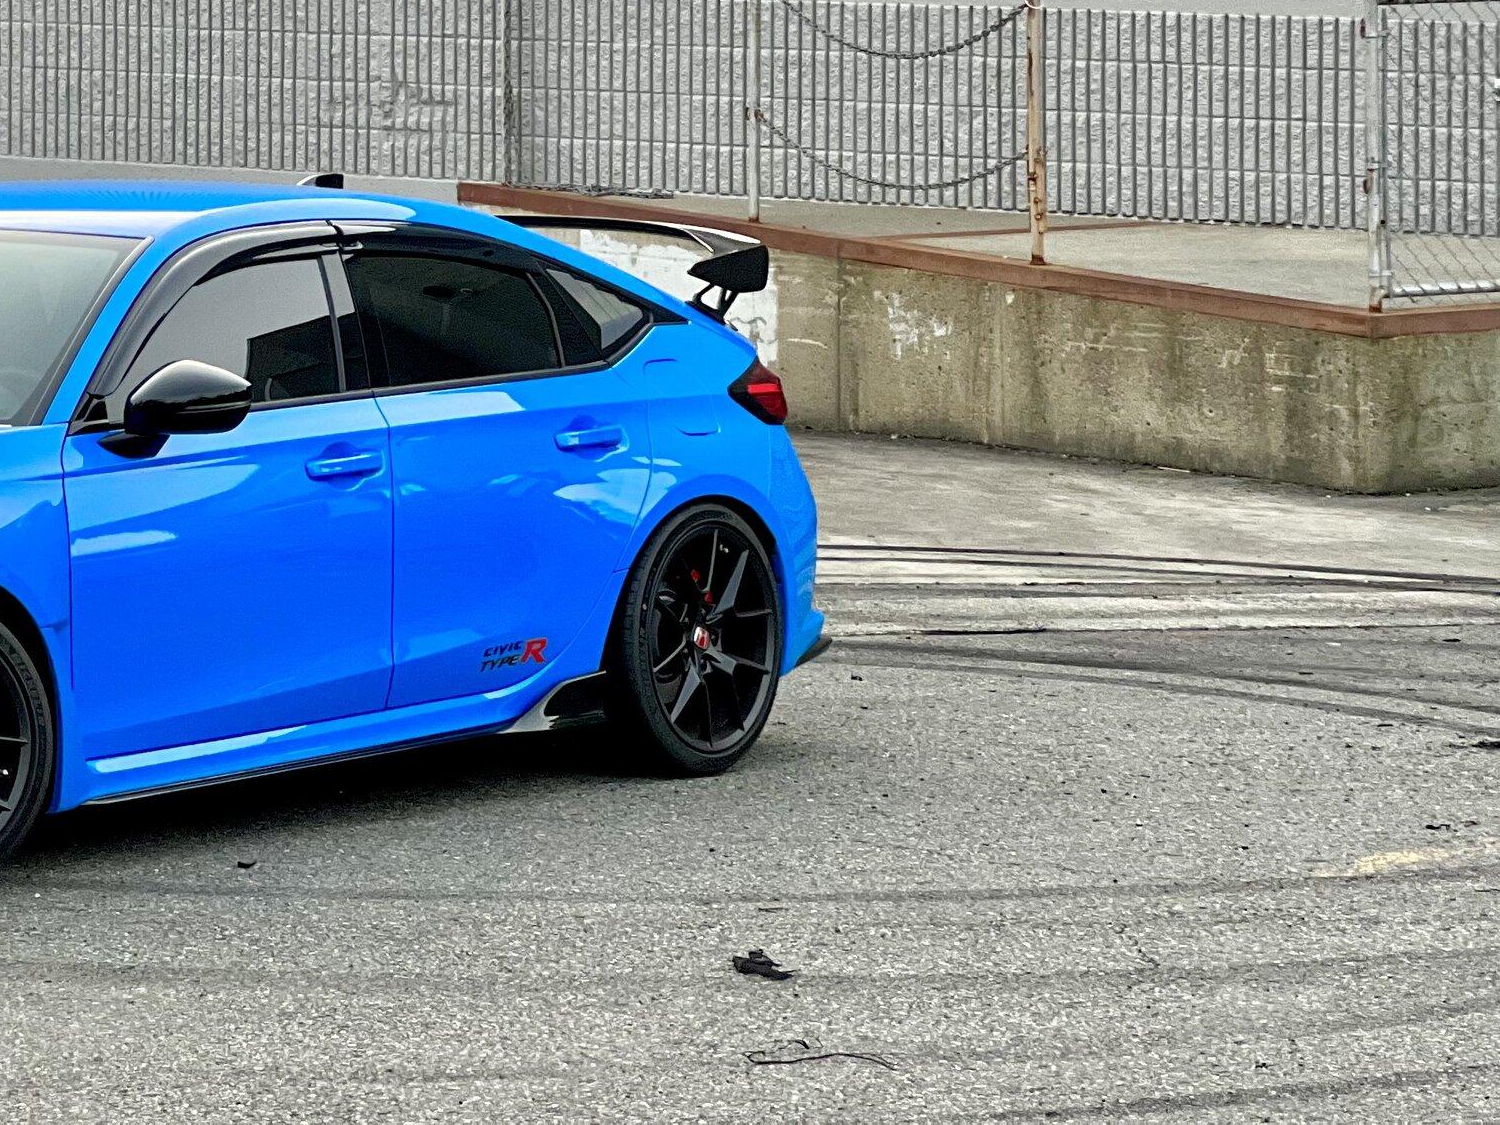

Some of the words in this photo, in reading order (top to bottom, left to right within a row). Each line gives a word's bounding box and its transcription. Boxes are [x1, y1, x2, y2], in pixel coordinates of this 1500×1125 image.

[480, 654, 521, 673] TYPE
[520, 637, 548, 664] R
[483, 640, 524, 657] CIVIC
